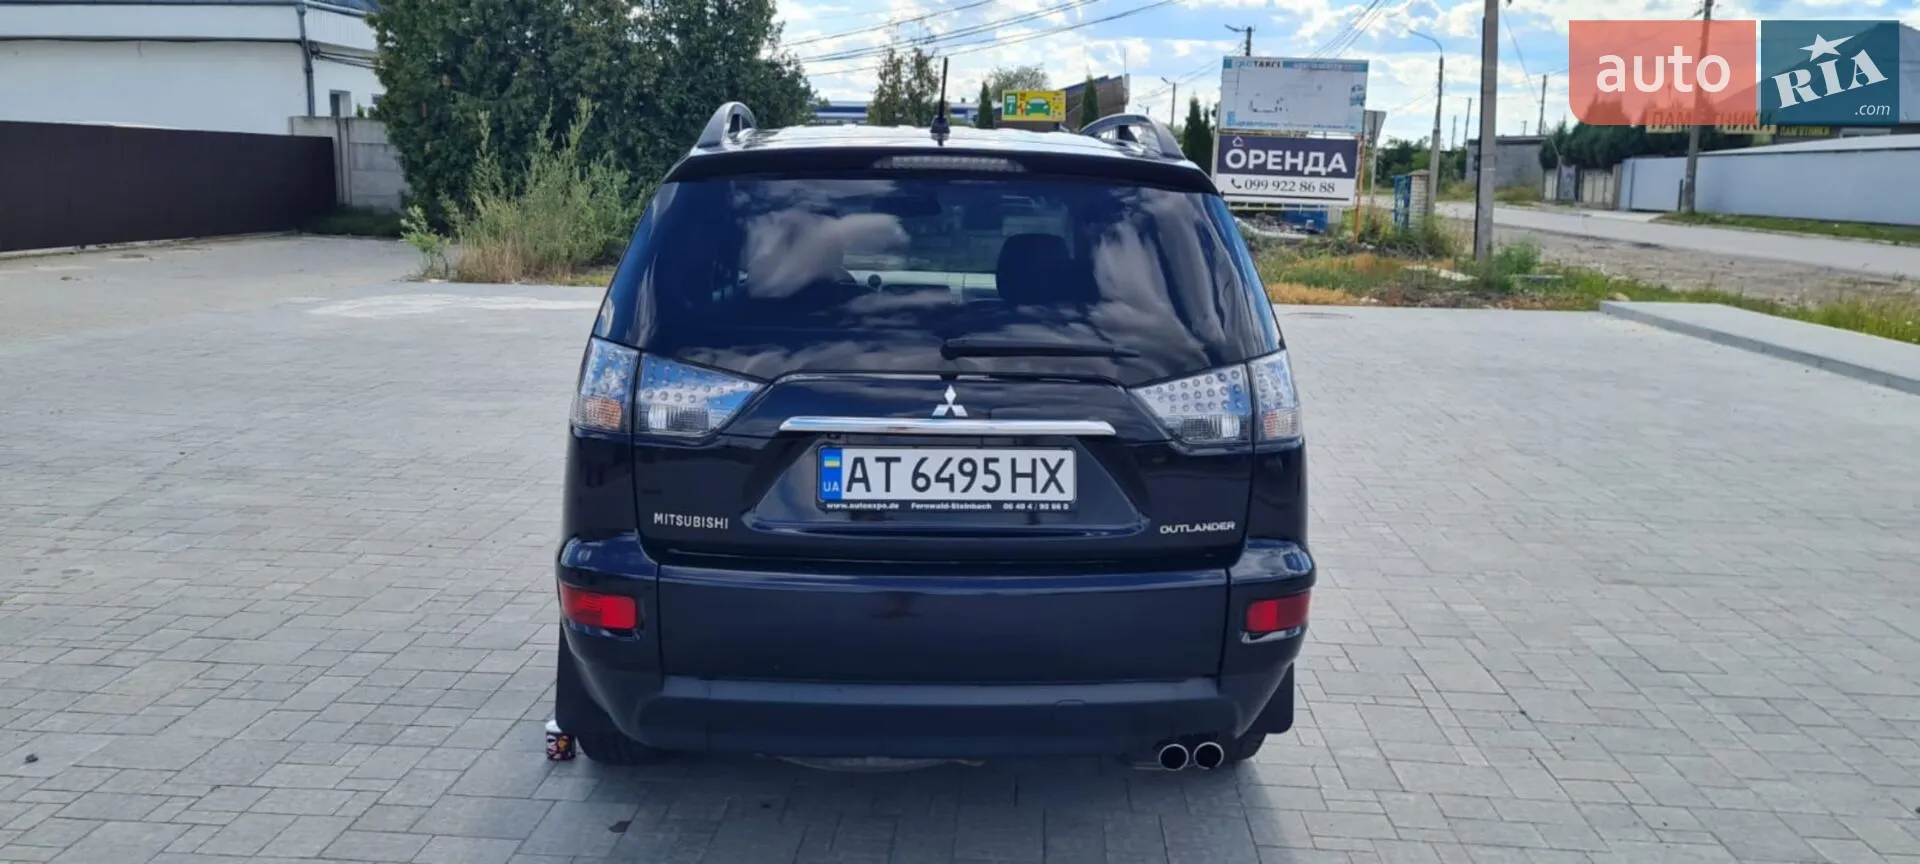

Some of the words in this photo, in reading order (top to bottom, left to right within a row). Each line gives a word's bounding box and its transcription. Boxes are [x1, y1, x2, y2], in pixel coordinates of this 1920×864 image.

[1225, 148, 1348, 176] ОРЕНДА
[1244, 179, 1269, 191] 099
[1272, 179, 1296, 192] 922
[1300, 180, 1317, 193] 86
[1319, 181, 1335, 193] 88
[846, 456, 902, 493] AT
[911, 456, 1001, 494] 6495
[1010, 457, 1066, 494] HX
[823, 481, 840, 492] UA
[653, 512, 729, 530] MITSUBISHI
[1159, 521, 1236, 534] OUTLANDER
